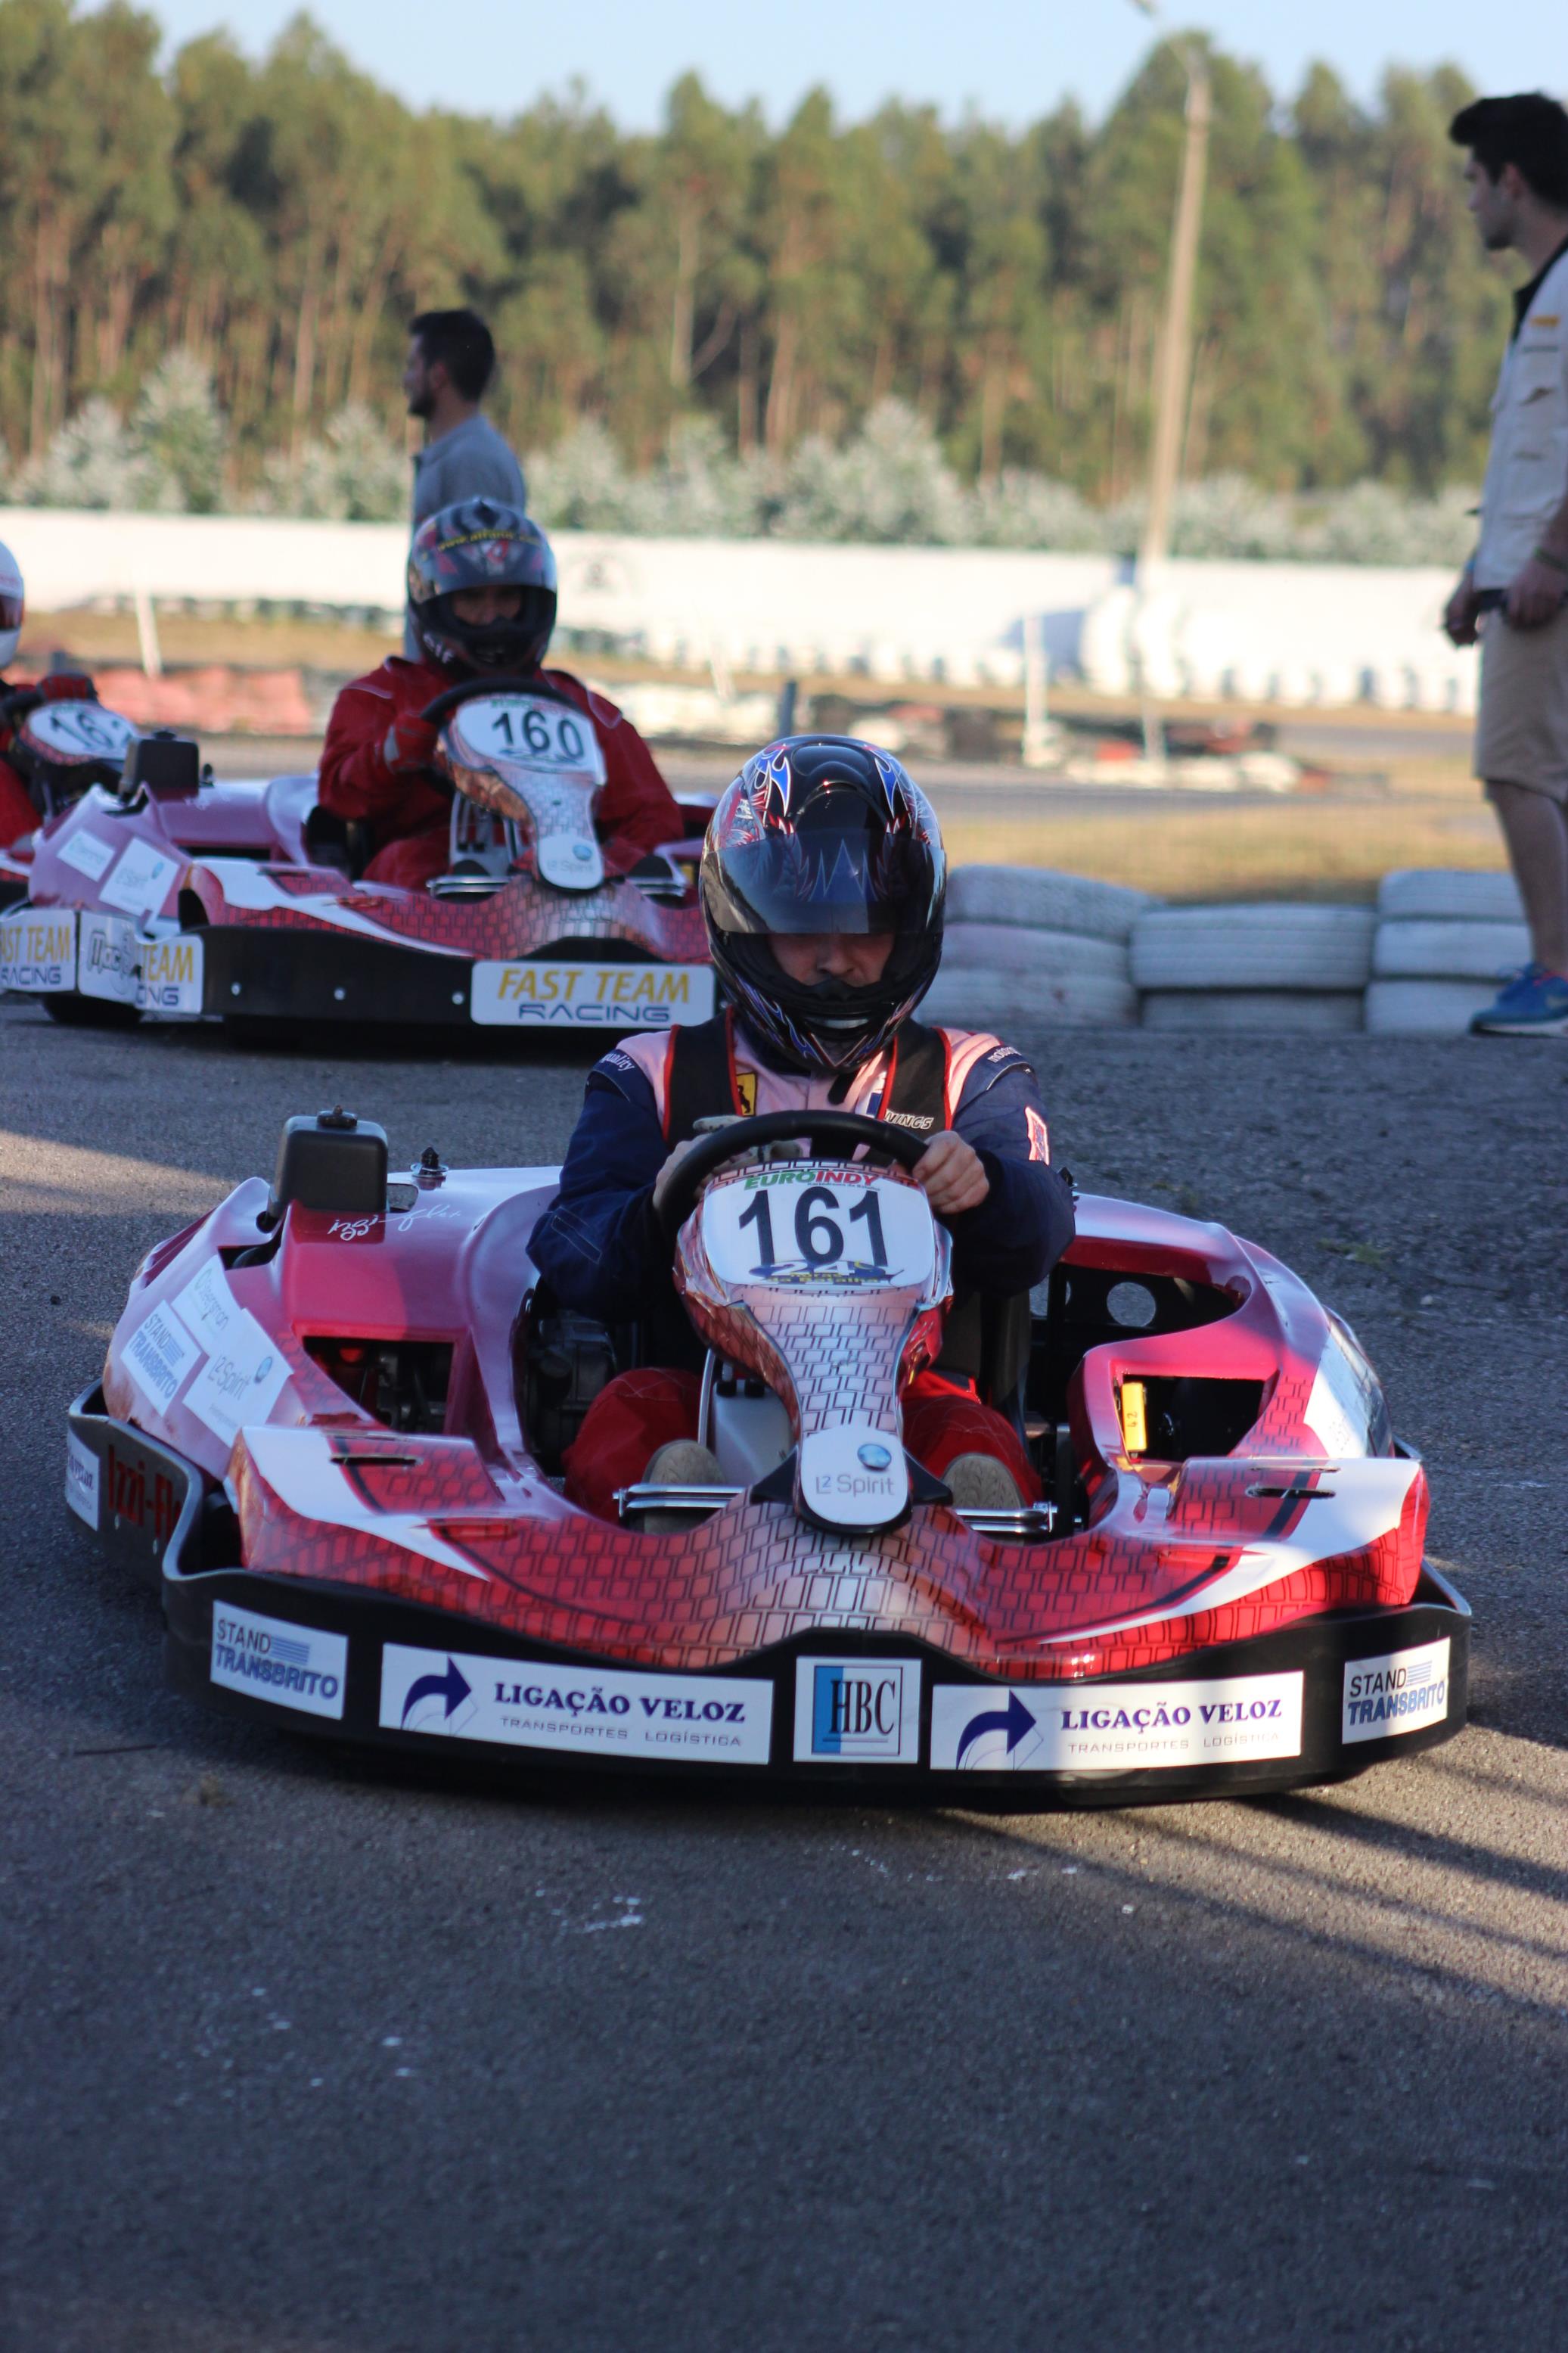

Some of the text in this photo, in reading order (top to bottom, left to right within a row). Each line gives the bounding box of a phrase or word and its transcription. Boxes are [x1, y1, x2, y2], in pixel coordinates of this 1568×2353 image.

[492, 710, 584, 760] 160
[28, 926, 70, 962] TEAM
[1, 966, 61, 985] RACING
[141, 944, 194, 982] TEAM
[497, 968, 690, 1004] FAST TEAM
[518, 1002, 670, 1022] RACING
[744, 1170, 880, 1191] EUROINDY
[738, 1186, 888, 1267] 161
[144, 1313, 171, 1351] STAND
[836, 1473, 896, 1498] Spirit
[216, 1618, 272, 1654] STAND
[216, 1643, 339, 1699] TRANSBRITO
[1349, 1668, 1407, 1699] STAND
[494, 1682, 746, 1724] LIGAÇÃO VELOZ
[829, 1679, 896, 1736] HBC
[1060, 1699, 1282, 1734] LIGAÇÃO VELOZ
[1347, 1680, 1445, 1727] TRANSBRITO
[500, 1716, 742, 1747] TRANSPORTES LOGÍSTICA
[1067, 1739, 1190, 1754] TRANSPORTES
